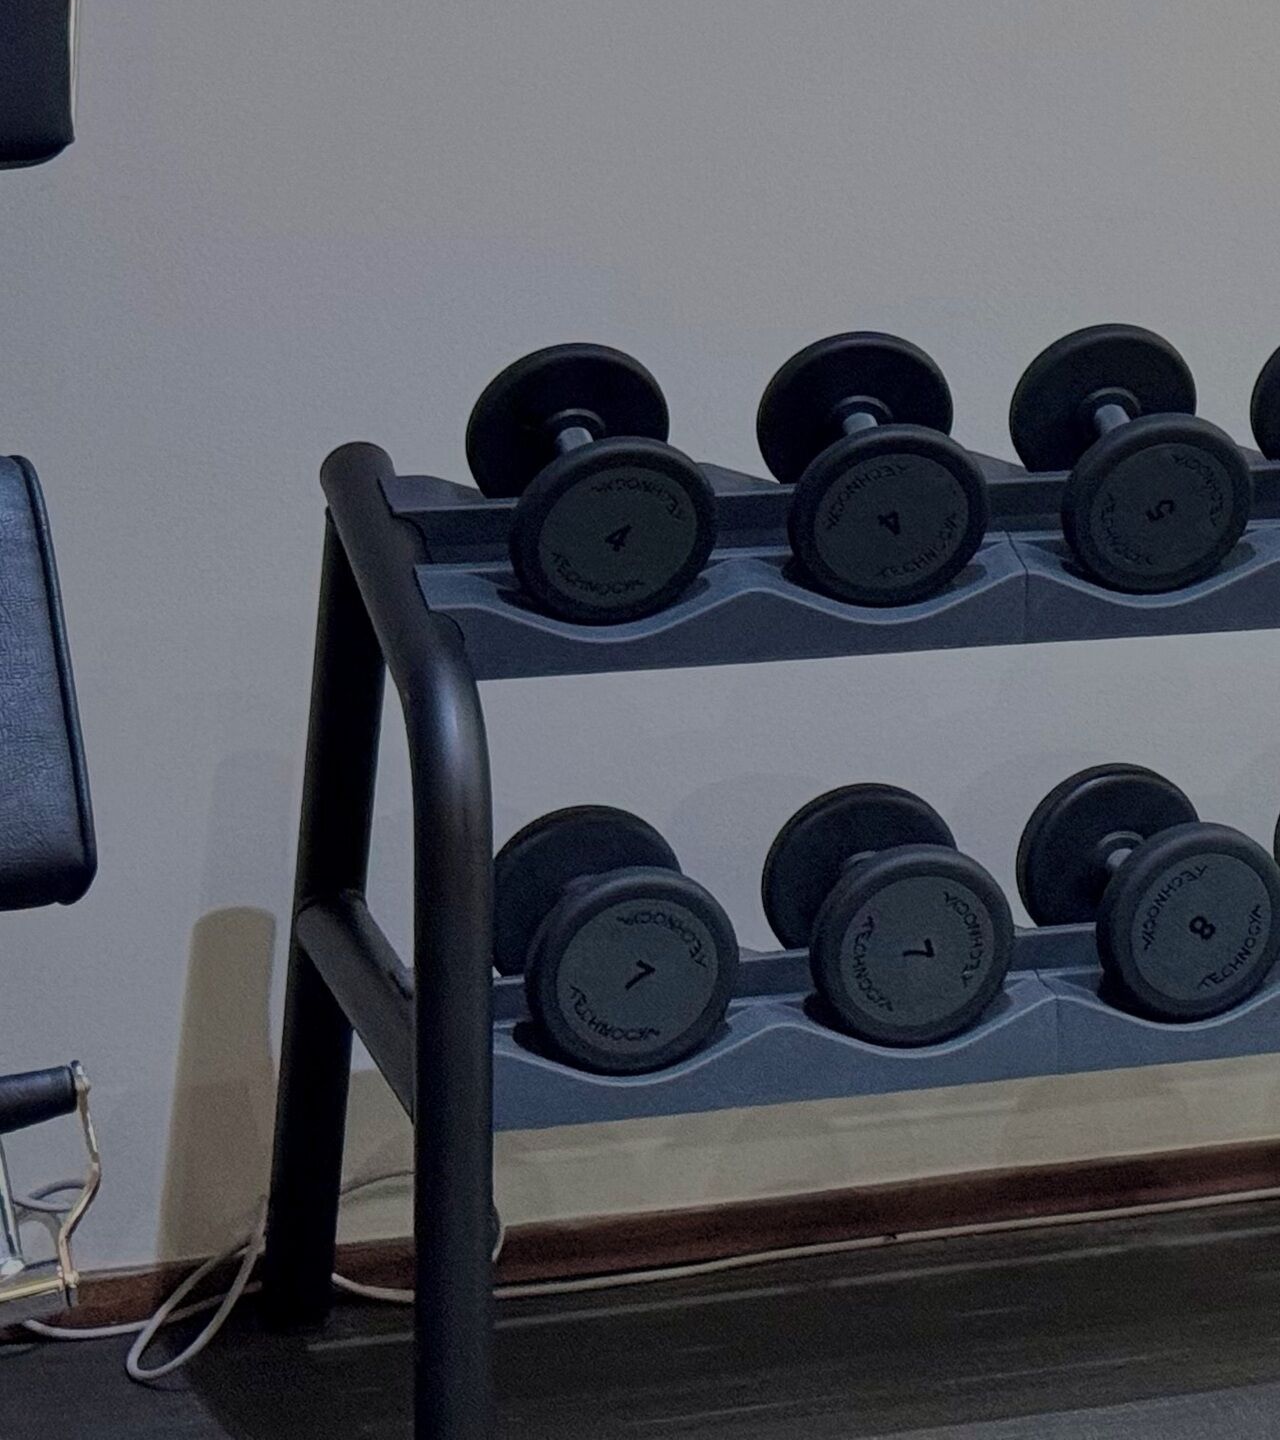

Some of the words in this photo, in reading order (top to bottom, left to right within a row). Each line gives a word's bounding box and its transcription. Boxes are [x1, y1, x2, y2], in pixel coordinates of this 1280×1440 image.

[877, 510, 901, 536] 4
[1145, 499, 1175, 522] 5
[604, 524, 632, 552] 4
[1188, 915, 1216, 940] 8
[902, 939, 935, 958] 7
[624, 960, 656, 991] 7
